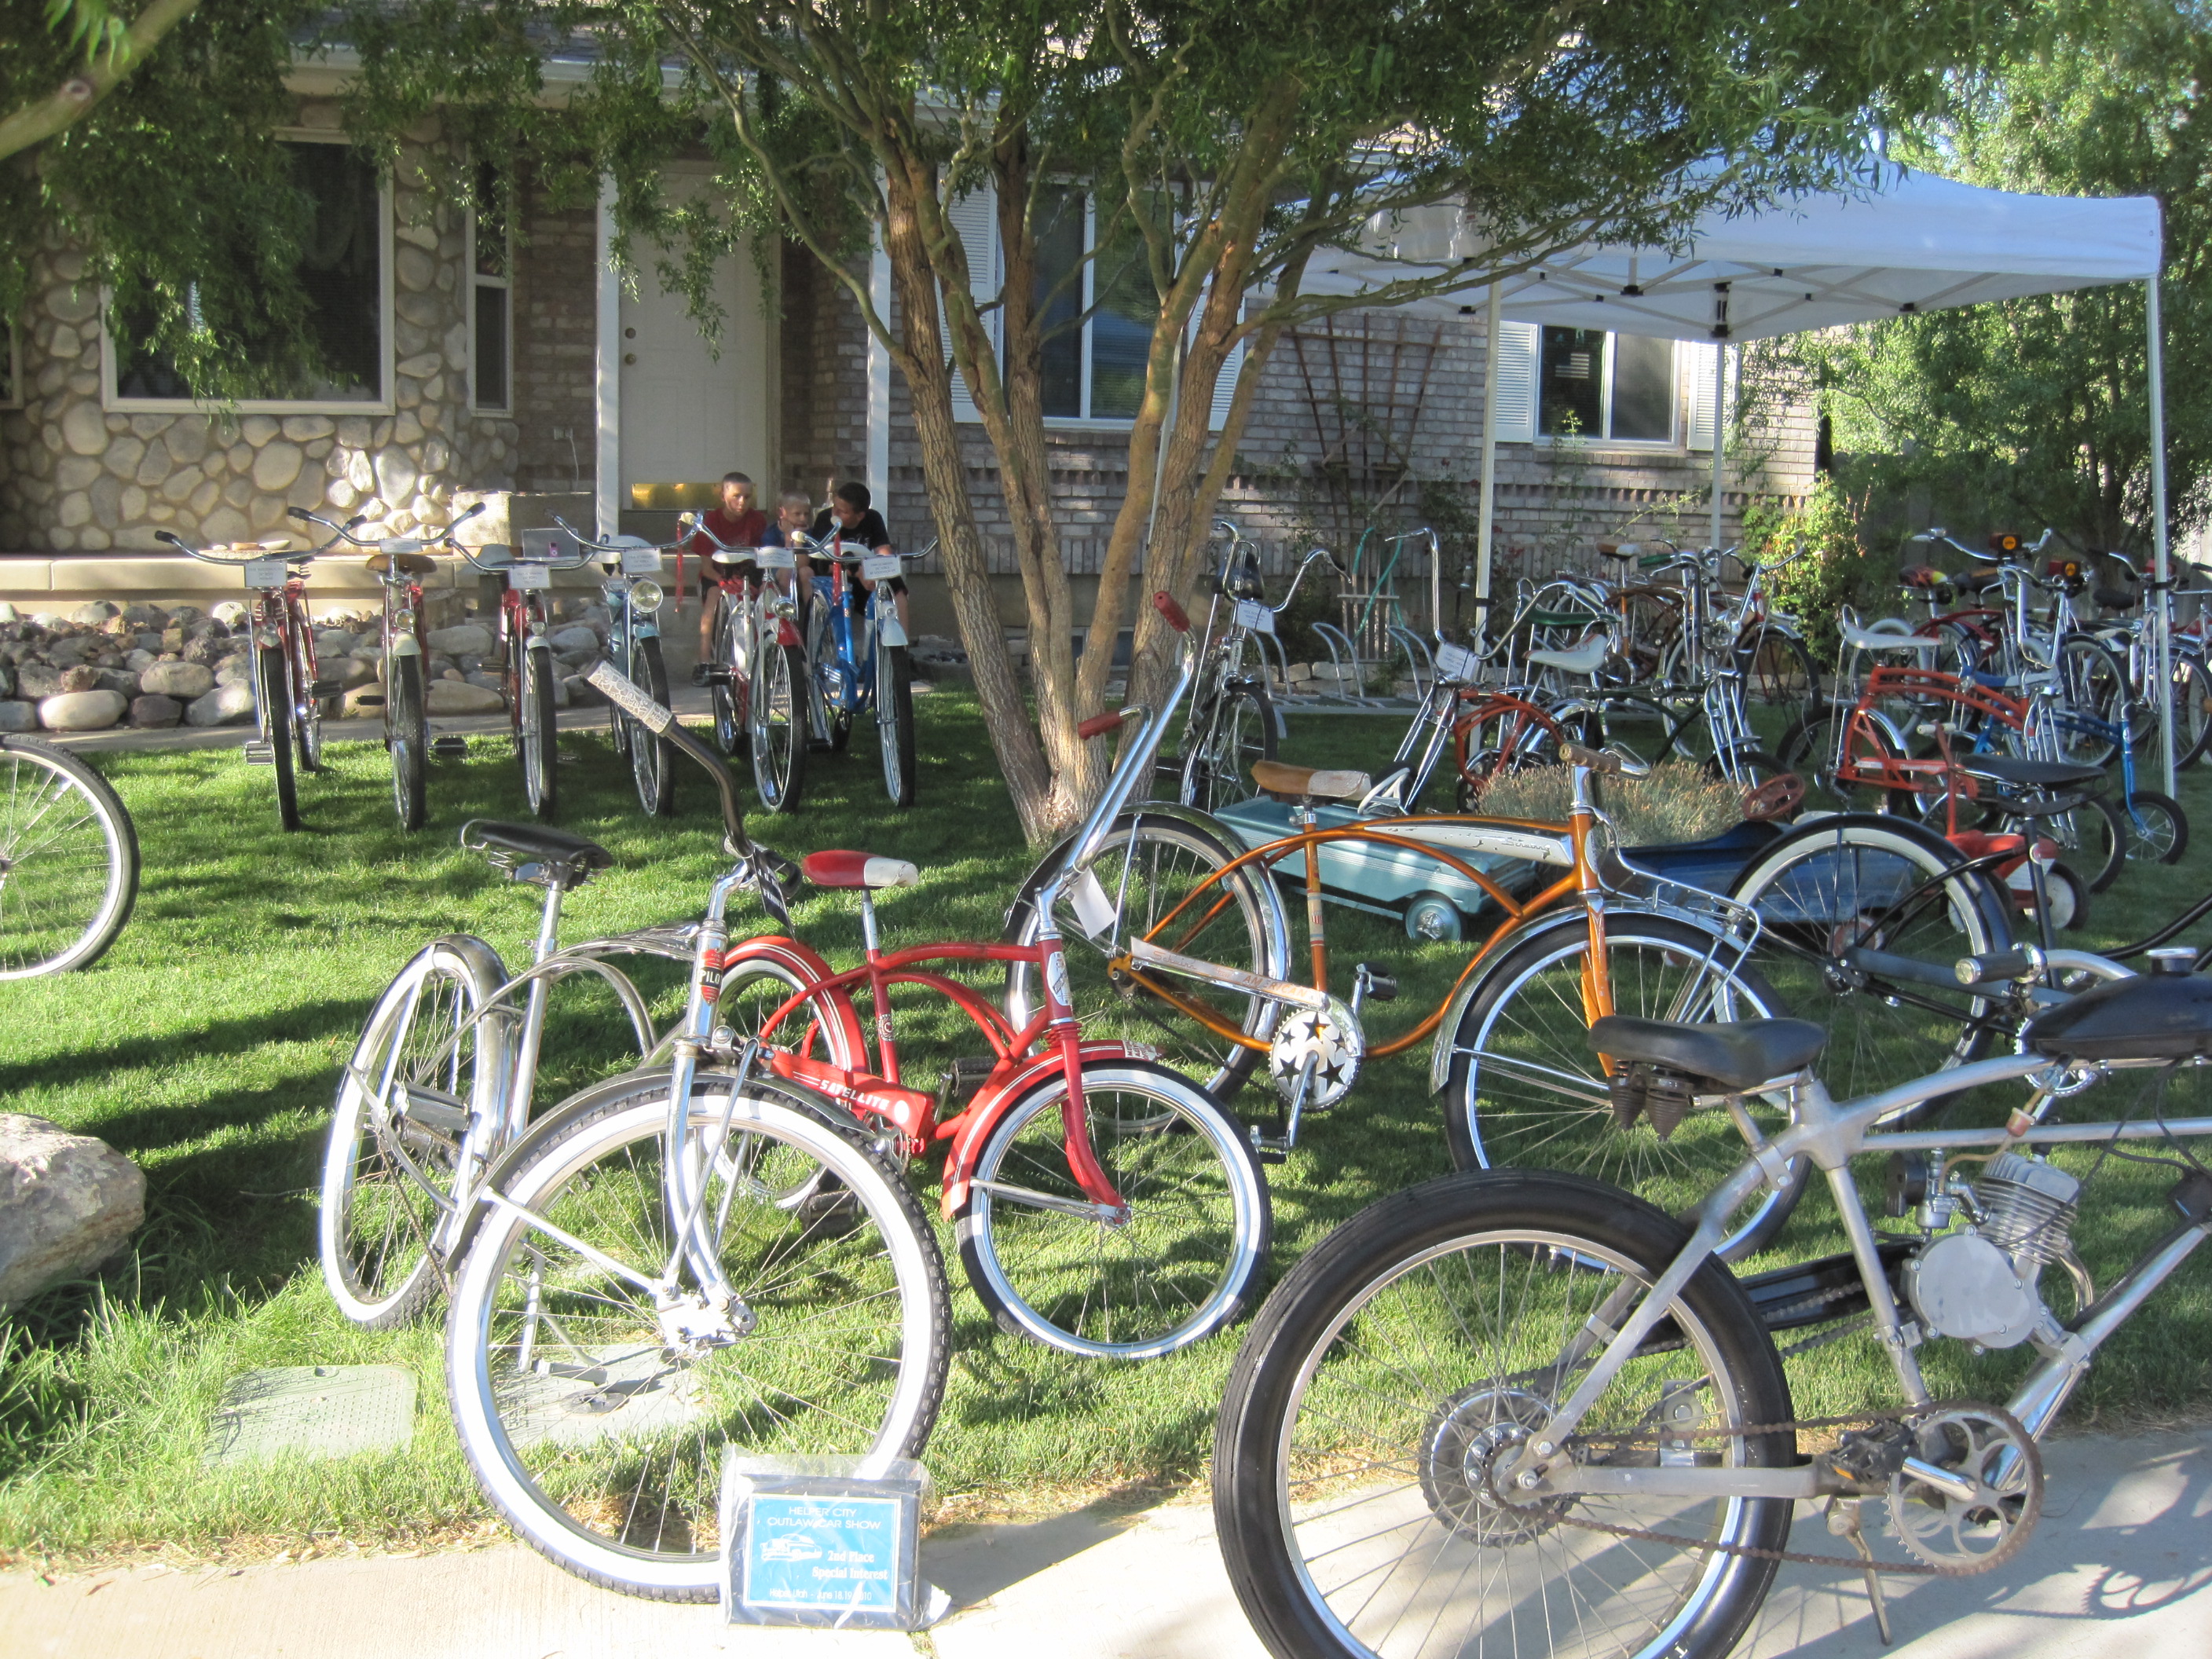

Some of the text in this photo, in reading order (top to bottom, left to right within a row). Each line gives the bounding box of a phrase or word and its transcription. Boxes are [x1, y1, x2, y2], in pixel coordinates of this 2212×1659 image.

[698, 969, 722, 984] PILO
[819, 1079, 890, 1110] SATELLITE
[789, 1506, 857, 1517] HELPER CITY
[767, 1517, 881, 1529] OUTLAW CAR SHOW
[827, 1550, 874, 1562] 2nd Place
[811, 1566, 888, 1580] Special Interest
[816, 1590, 833, 1599] June
